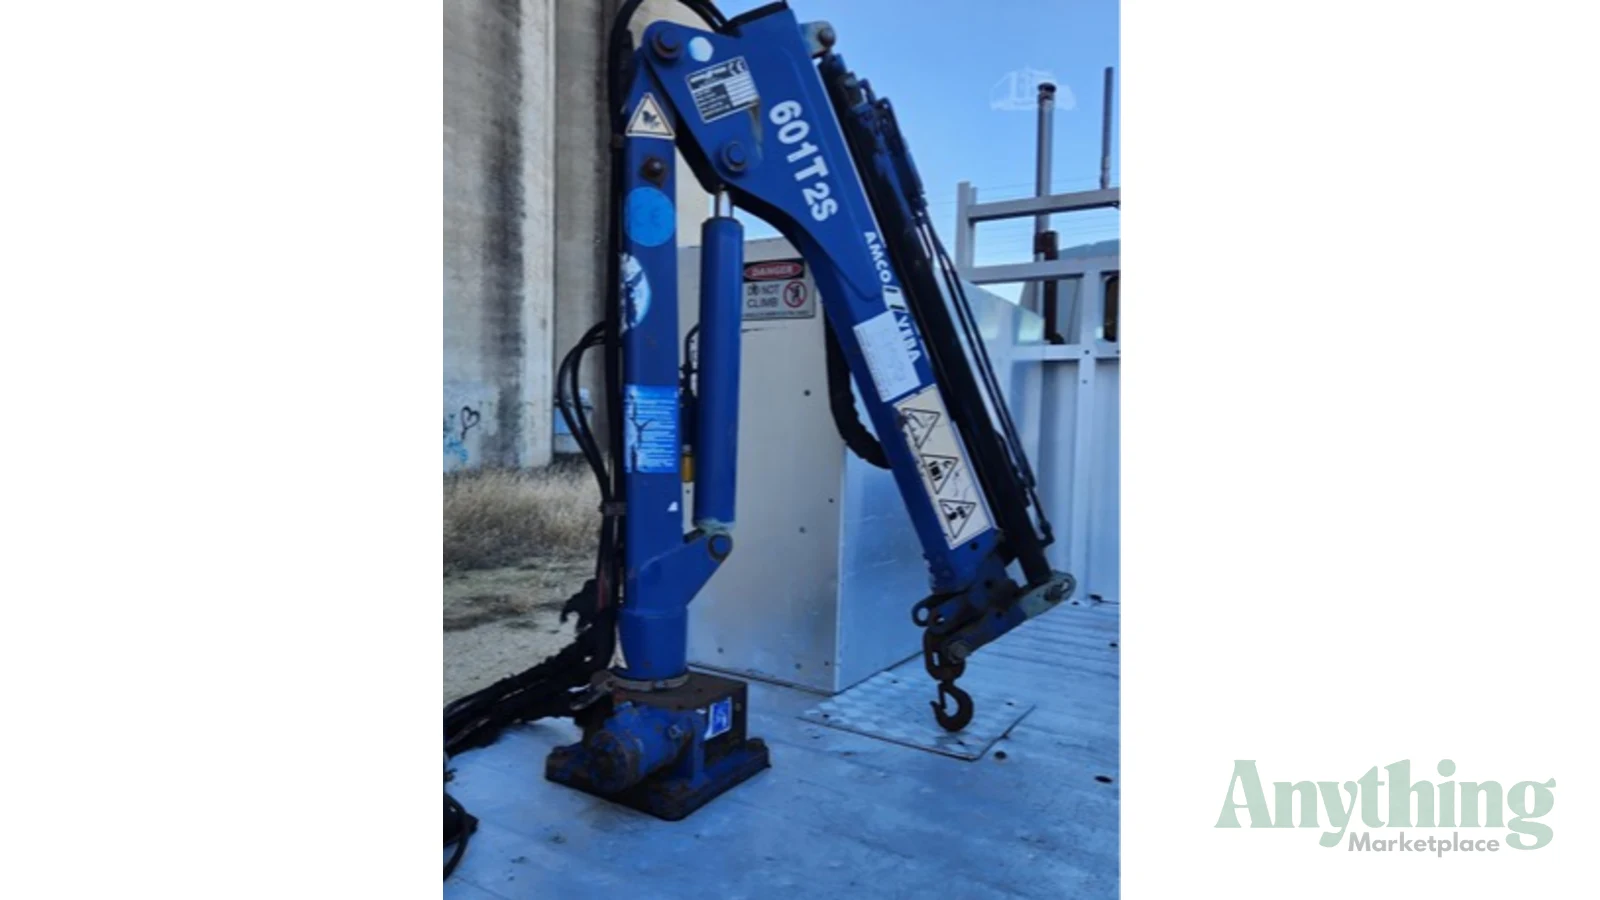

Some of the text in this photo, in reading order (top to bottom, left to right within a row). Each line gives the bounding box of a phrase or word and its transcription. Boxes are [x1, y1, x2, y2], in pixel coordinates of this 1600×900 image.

[864, 232, 892, 283] AMCO
[762, 284, 780, 294] NOT
[747, 297, 778, 308] CLIMB
